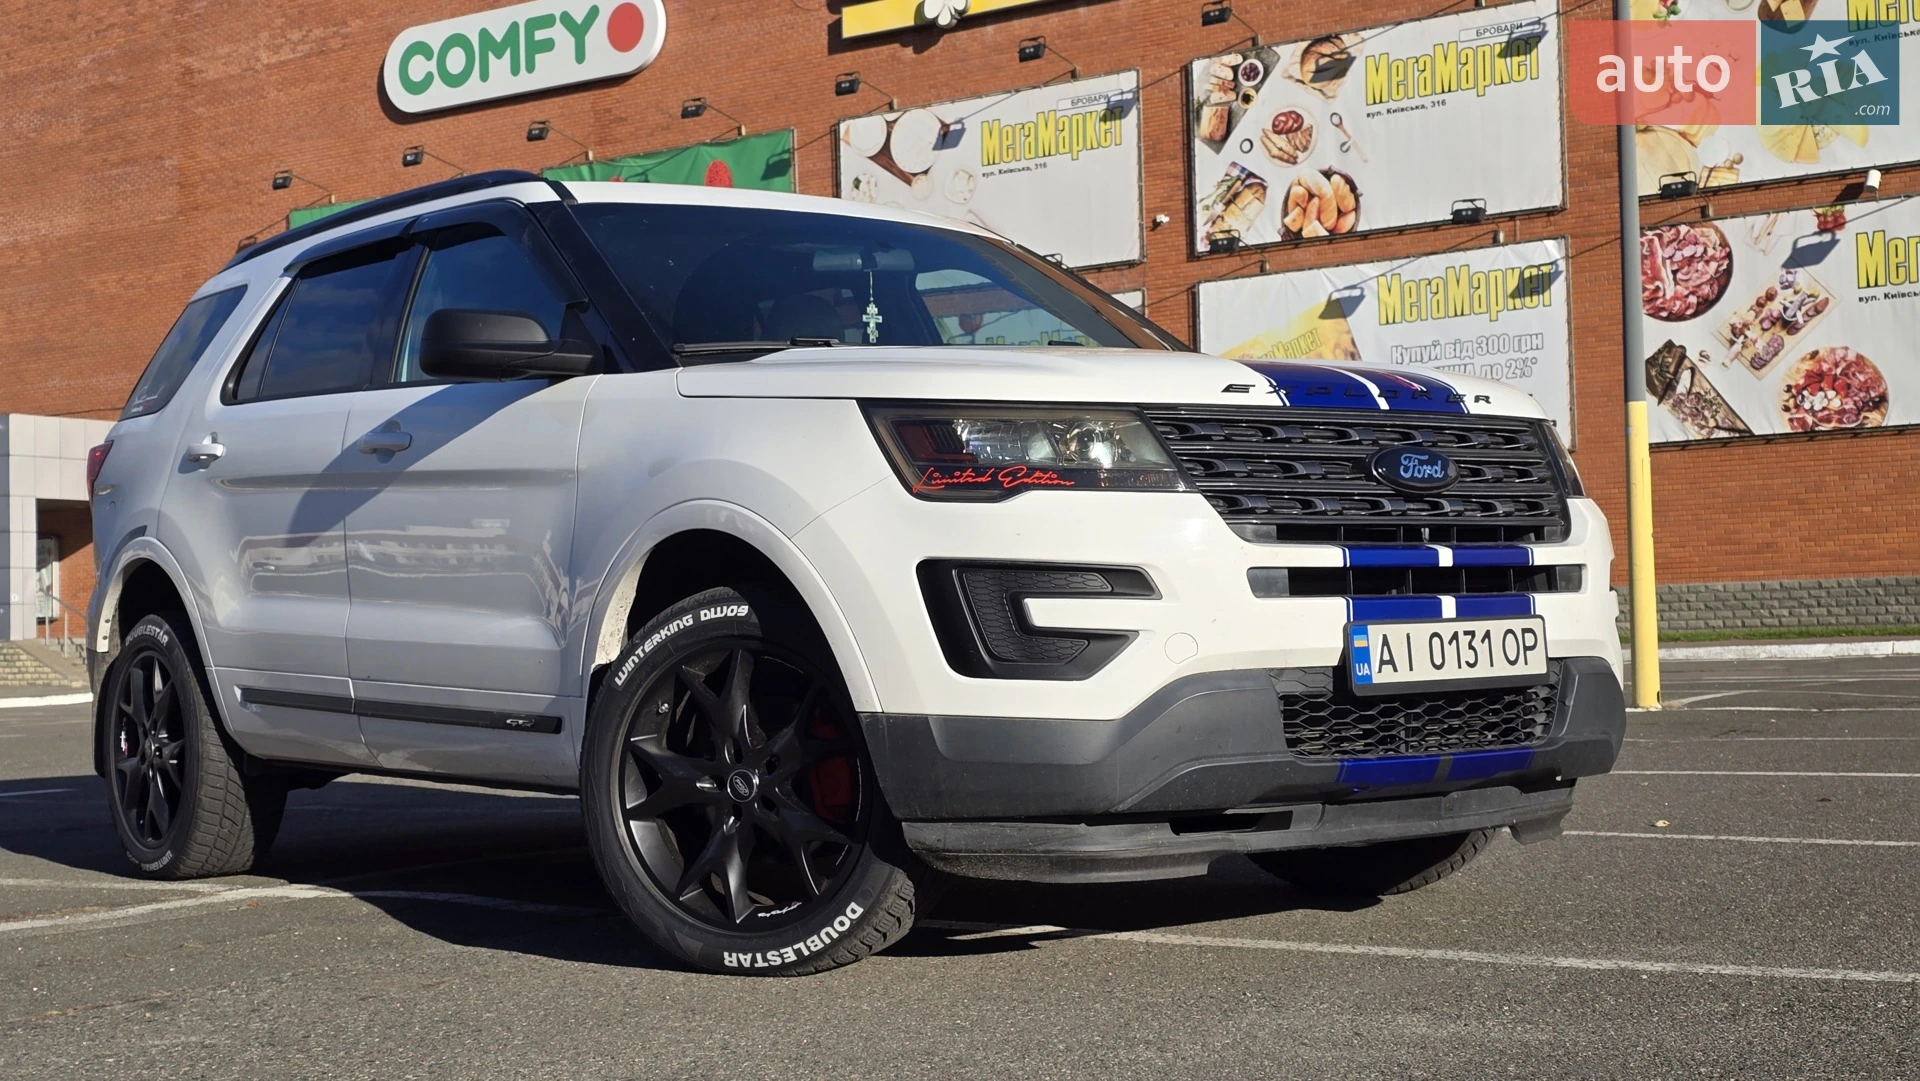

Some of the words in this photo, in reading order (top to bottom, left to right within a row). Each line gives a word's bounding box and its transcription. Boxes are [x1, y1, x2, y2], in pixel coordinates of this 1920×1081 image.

[1475, 22, 1524, 38] БРОВАРИ
[1848, 37, 1871, 48] вул.
[398, 4, 600, 96] COMFY
[1365, 34, 1542, 106] МегаМаркет
[1070, 93, 1110, 108] БРОВАРИ
[1366, 108, 1385, 119] вул.
[1386, 102, 1428, 116] Київська,
[980, 105, 1125, 167] МегаМаркет
[981, 171, 997, 179] вул.
[1377, 263, 1553, 326] МегаМаркет
[1858, 295, 1881, 304] вул.
[1390, 339, 1443, 366] Купуй
[1444, 337, 1475, 361] від
[1476, 332, 1511, 357] 300
[1512, 331, 1544, 355] грн
[1221, 383, 1492, 406] EXPLORER
[912, 467, 993, 494] Limited
[997, 466, 1075, 489] Edition
[1399, 453, 1446, 480] Ford
[614, 613, 695, 687] WINTERKING
[1376, 632, 1414, 674] AI
[1428, 628, 1495, 671] 0131
[1501, 626, 1539, 667] OP
[1355, 663, 1371, 676] UA
[723, 901, 864, 968] DOUBLESTAR
